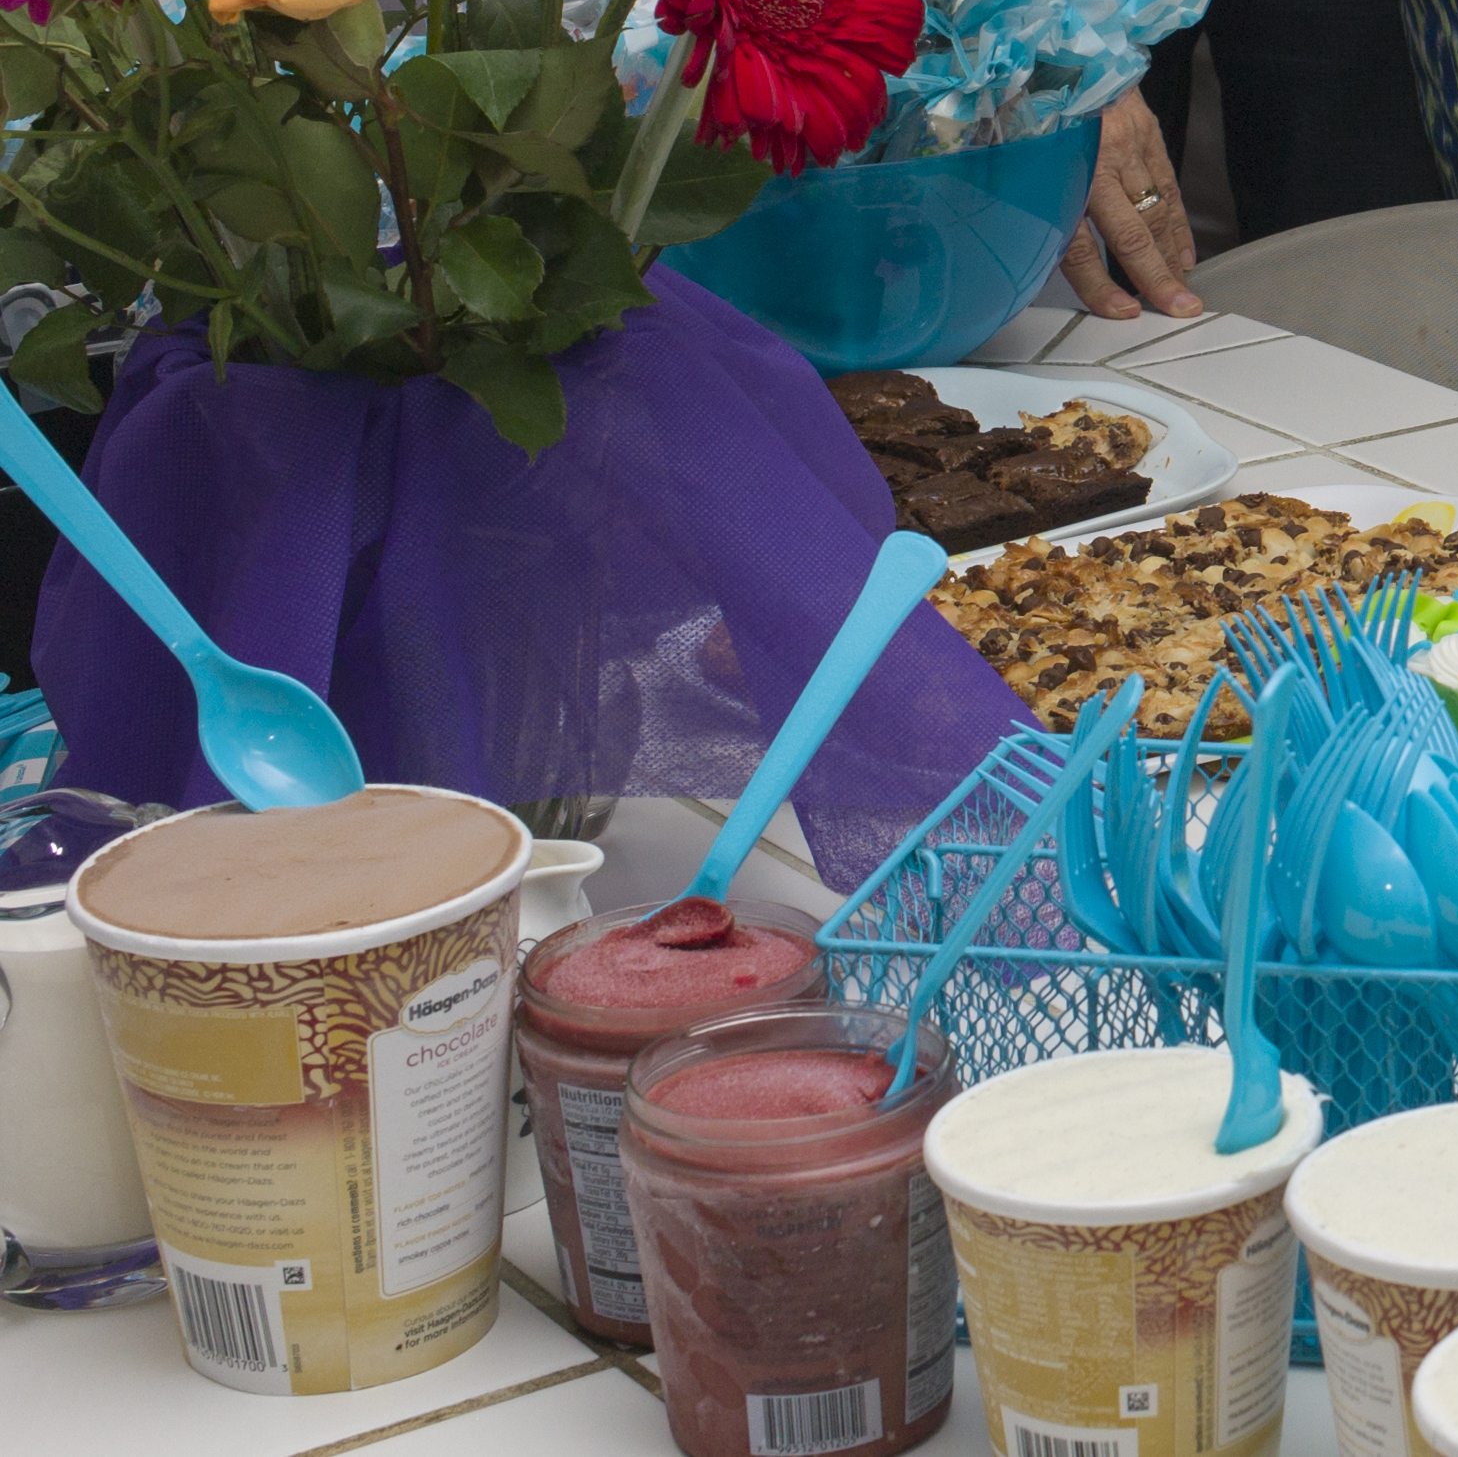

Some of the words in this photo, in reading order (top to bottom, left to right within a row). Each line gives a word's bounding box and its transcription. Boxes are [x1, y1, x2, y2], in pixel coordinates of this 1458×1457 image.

[408, 970, 498, 1022] Häagen-Dazs
[406, 1013, 498, 1068] chocolate
[560, 1086, 623, 1107] Nutrition
[346, 1179, 360, 1223] comments?
[352, 1235, 364, 1274] questions
[404, 1323, 425, 1338] visit
[405, 1336, 420, 1350] for
[423, 1325, 449, 1343] more
